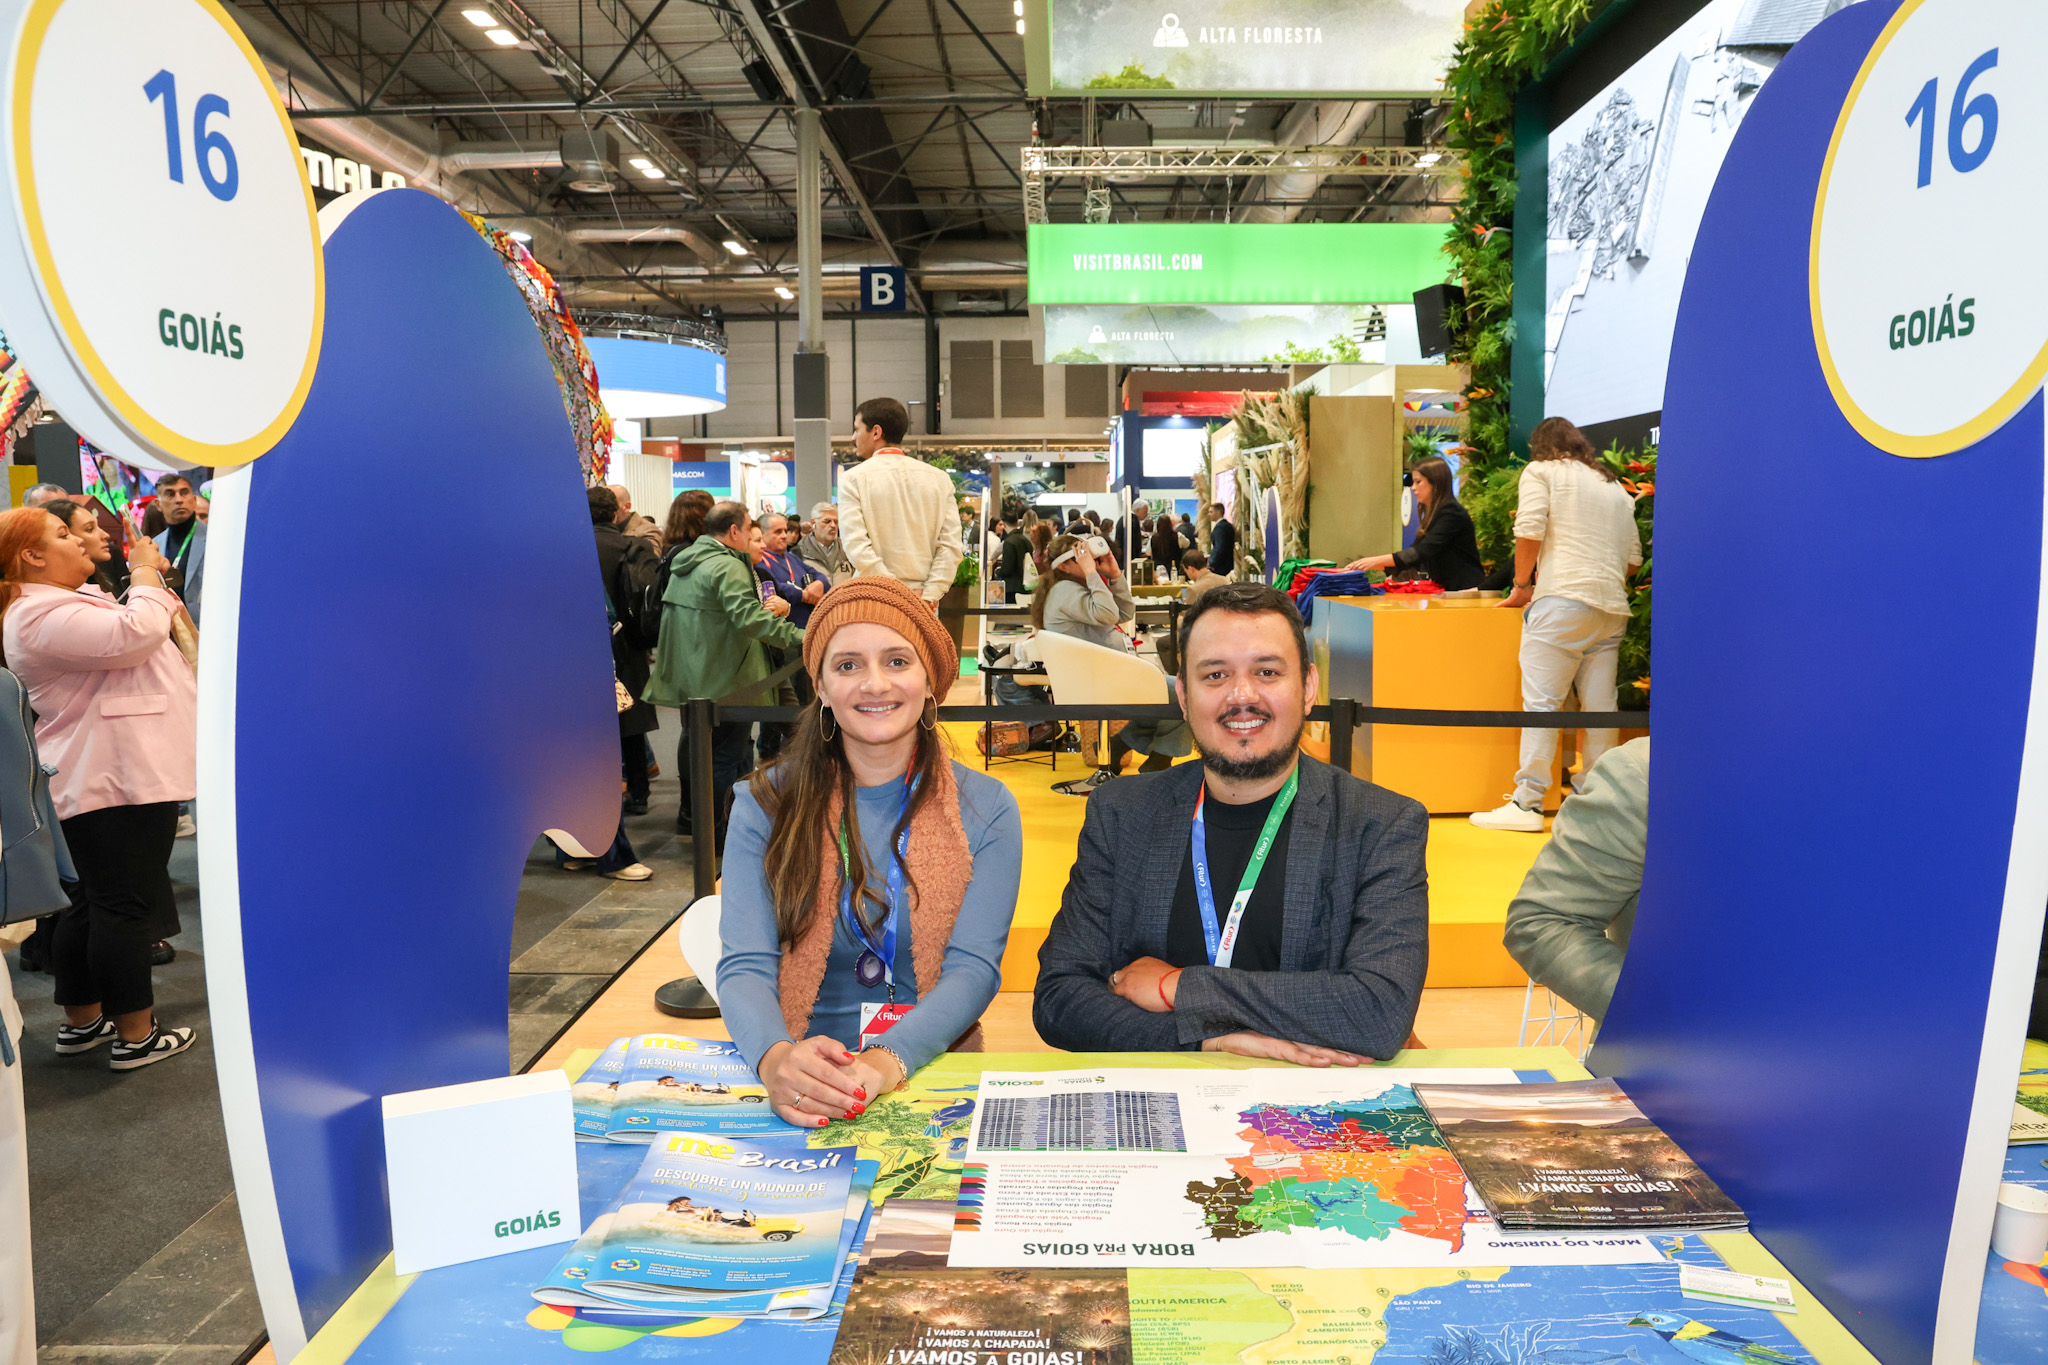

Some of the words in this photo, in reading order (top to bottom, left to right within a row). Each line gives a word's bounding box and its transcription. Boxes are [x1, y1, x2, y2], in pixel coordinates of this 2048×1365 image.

[1199, 27, 1236, 43] ALTA
[1244, 27, 1323, 43] FLORESTA
[1905, 47, 1999, 189] 16
[142, 68, 239, 201] 16
[1073, 253, 1203, 271] VISITBRASIL.COM
[871, 273, 895, 305] B
[1889, 294, 1975, 350] GOIÁS
[159, 312, 244, 359] GOIÁS
[1111, 331, 1131, 341] ALTA
[1134, 331, 1175, 341] FLORESTA
[703, 1044, 740, 1056] Br
[639, 1058, 699, 1070] DESCUBRE
[736, 1151, 842, 1173] Brasil
[654, 1168, 728, 1187] DESCUBRE
[731, 1180, 751, 1190] UN
[754, 1182, 804, 1192] MUNDO
[808, 1182, 827, 1191] DE
[1588, 1174, 1642, 1182] CHAPADA!
[1518, 1182, 1594, 1194] ¡VAMOS
[1601, 1185, 1613, 1194] A
[495, 1209, 561, 1238] GOIÁS
[1093, 1244, 1126, 1253] PRA
[1132, 1244, 1195, 1256] BORA
[967, 1329, 975, 1337] A
[976, 1328, 1040, 1338] NATURALEZA!
[917, 1337, 969, 1349] ¡VAMOS
[972, 1338, 982, 1349] A
[984, 1338, 1050, 1349] CHAPADA!
[886, 1349, 977, 1365] ¡VAMOS
[986, 1355, 999, 1365] A
